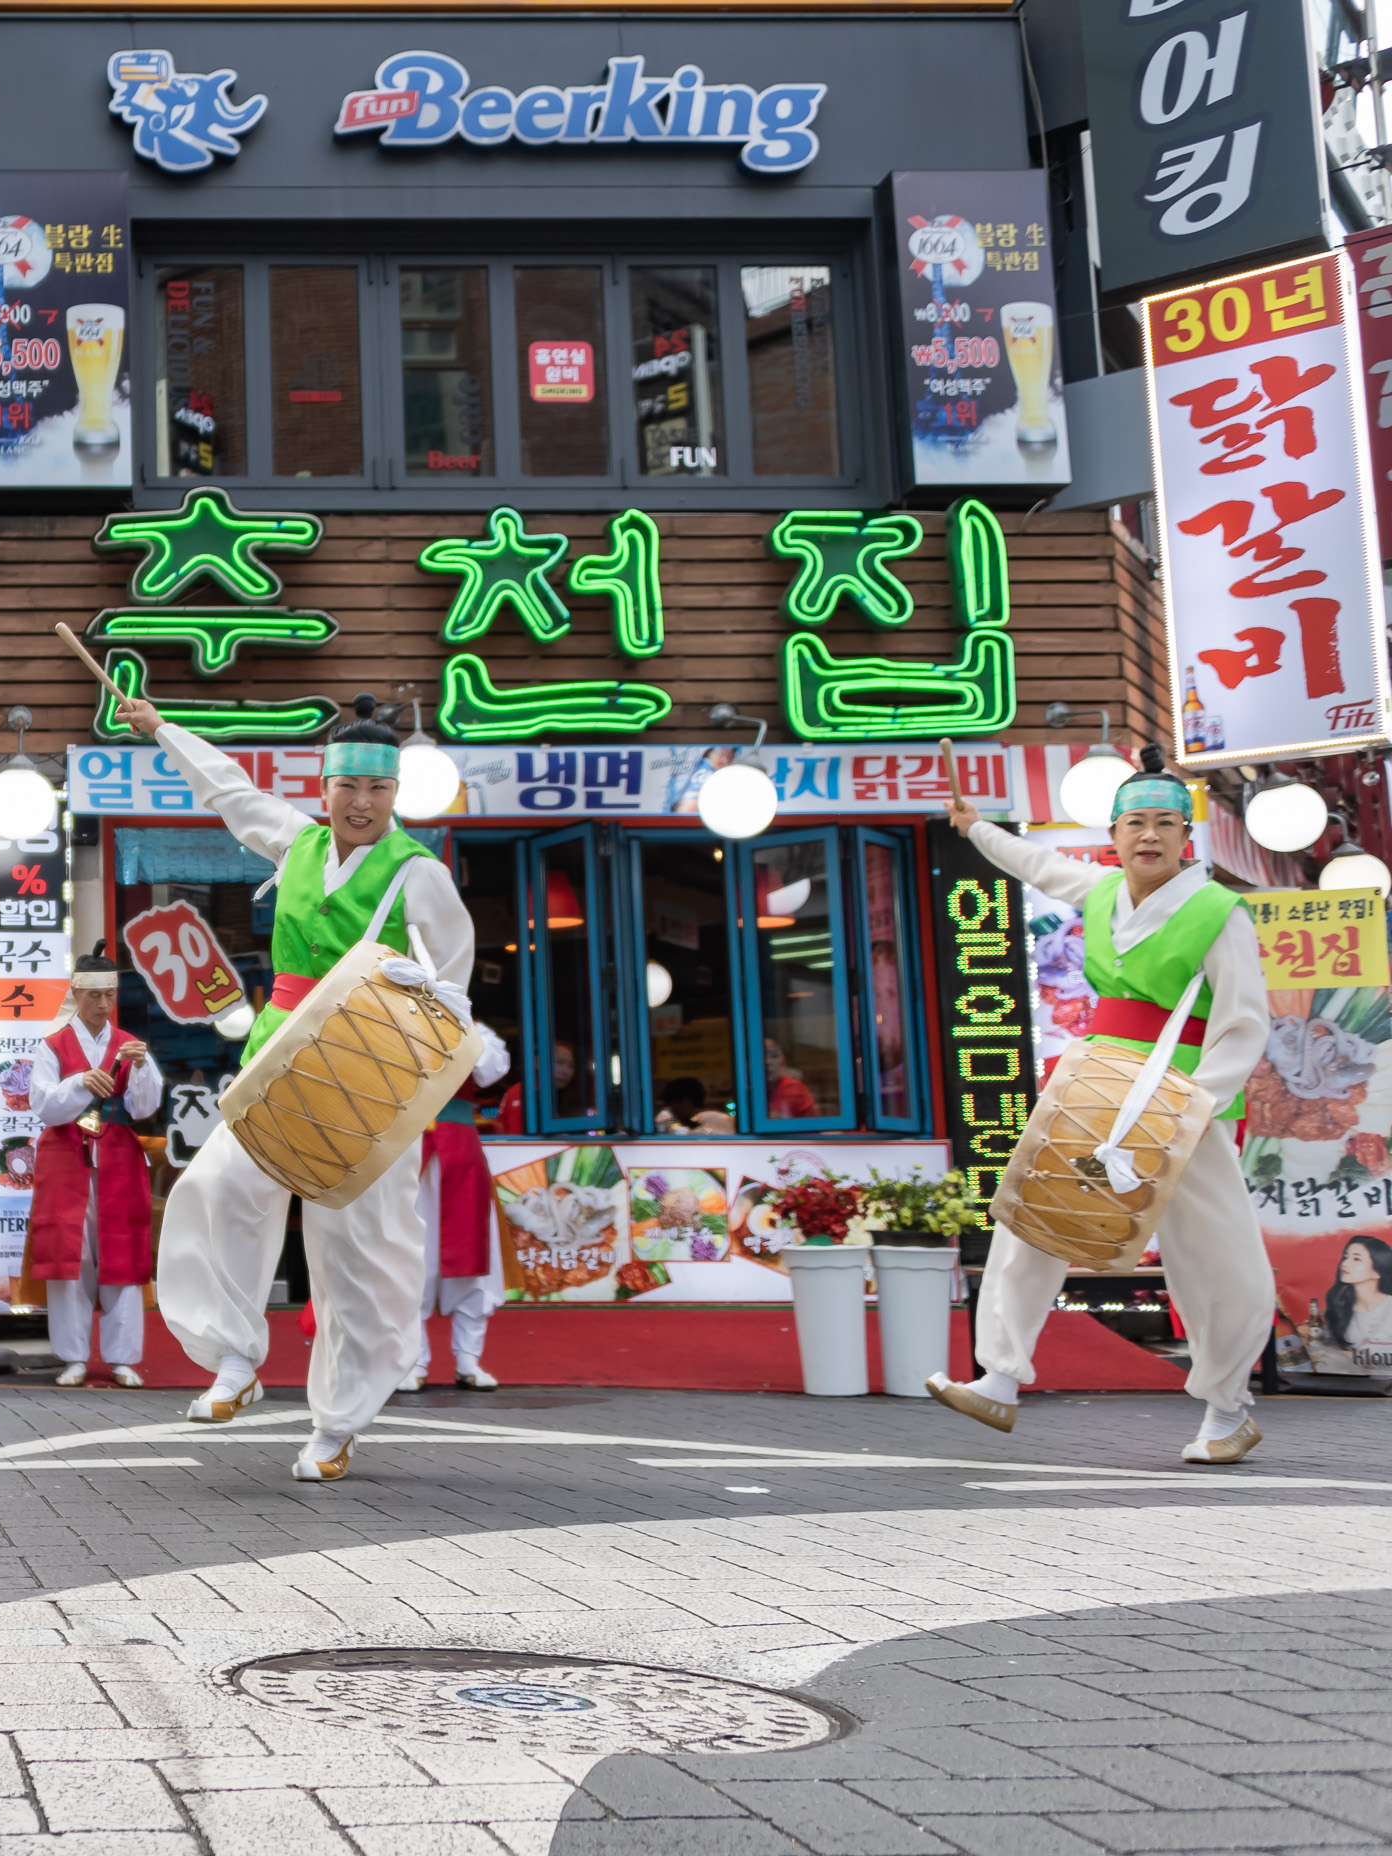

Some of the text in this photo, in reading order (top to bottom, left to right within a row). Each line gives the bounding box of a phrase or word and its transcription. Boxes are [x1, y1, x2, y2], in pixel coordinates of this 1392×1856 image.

[353, 50, 828, 171] fun Beerking
[1128, 0, 1263, 236] 어킹
[45, 223, 124, 249] 블랑 生
[917, 233, 957, 257] 1664
[975, 222, 1047, 249] 블랑 生
[53, 252, 114, 273] 특판점
[986, 250, 1041, 272] 특판점
[1163, 265, 1328, 355] 30년
[534, 347, 587, 365] 흡연실
[943, 401, 977, 427] 1위
[427, 450, 481, 469] Beer
[669, 446, 717, 468] FUN
[1168, 355, 1346, 700] 닭갈비
[86, 487, 1018, 742] 춘천집
[1325, 697, 1377, 732] Fitz
[76, 750, 195, 811] 얼음
[515, 750, 644, 811] 냉면
[851, 753, 1009, 801] 닭갈비
[1287, 900, 1332, 923] 소문난
[139, 922, 243, 1014] 30년
